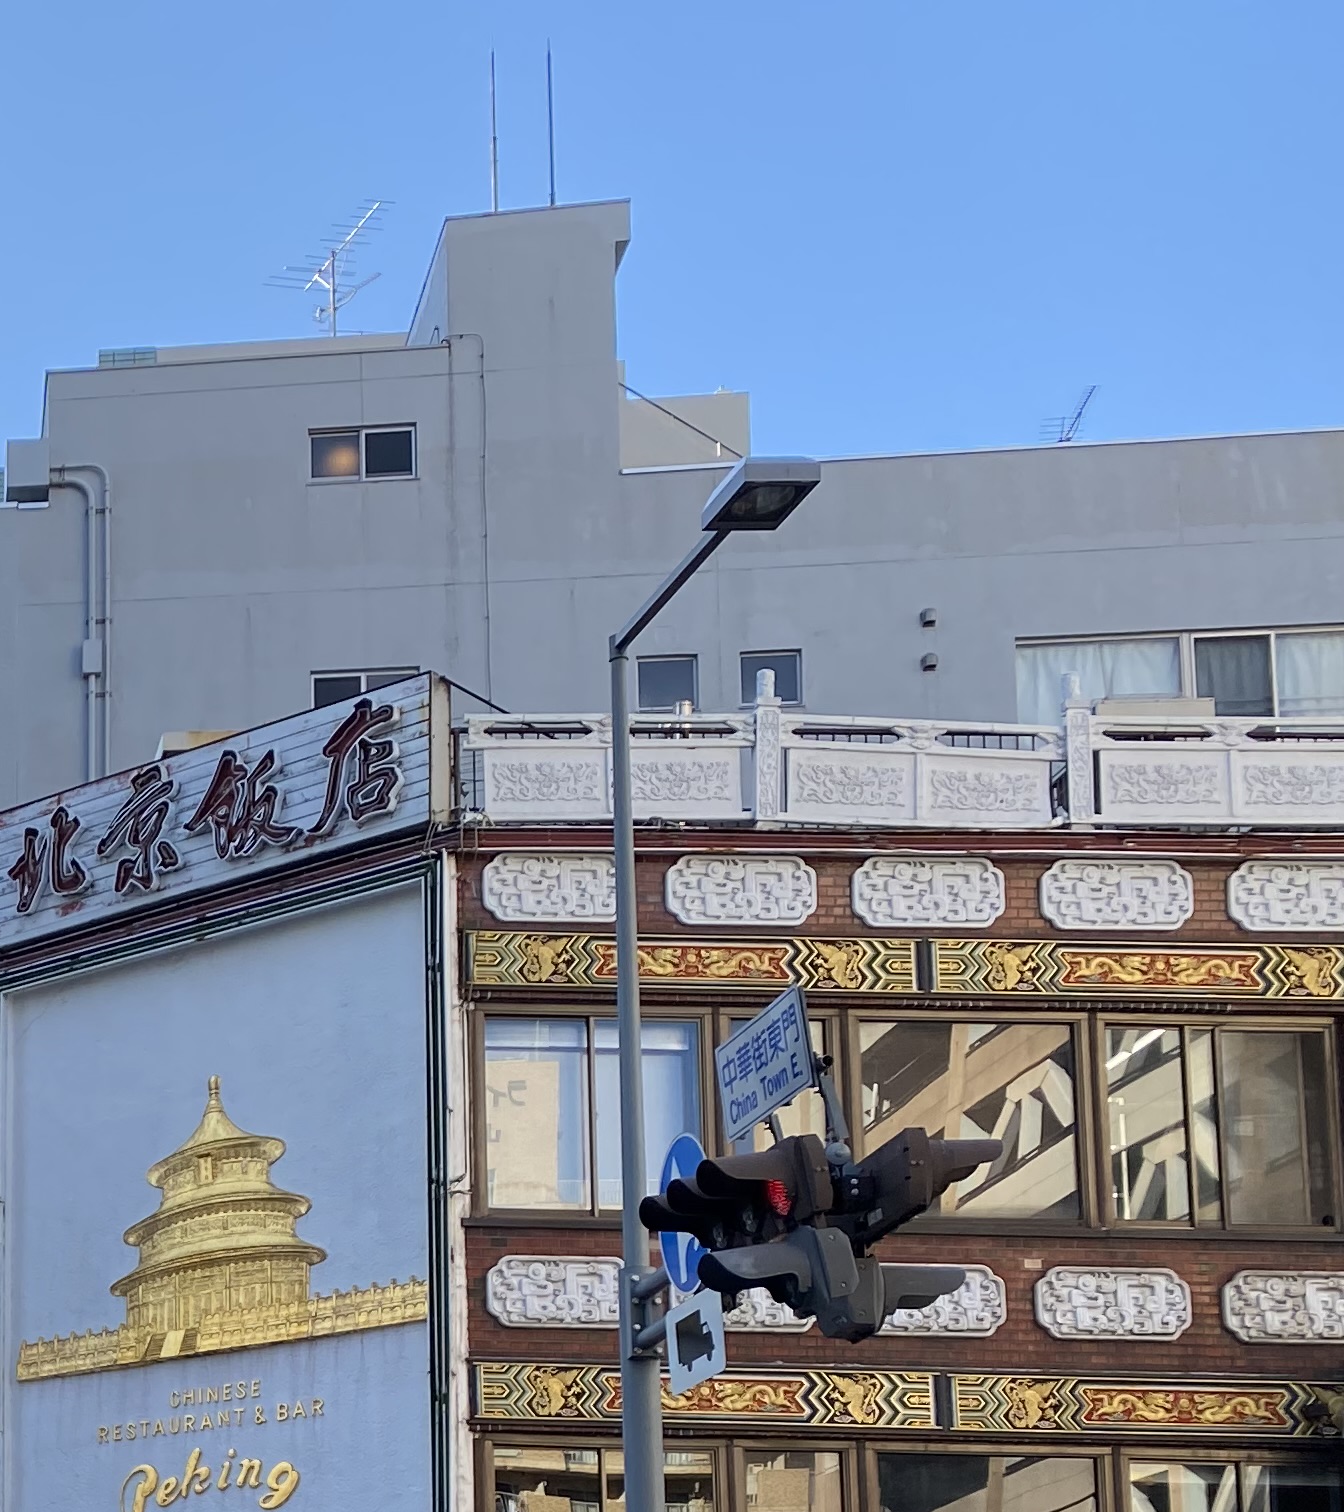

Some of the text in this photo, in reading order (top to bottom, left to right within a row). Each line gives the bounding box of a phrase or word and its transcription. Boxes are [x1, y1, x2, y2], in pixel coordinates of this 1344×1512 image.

[8, 697, 406, 915] 北京飯店
[721, 1003, 800, 1095] 中華街東門
[729, 1052, 804, 1125] China Town E.
[96, 1398, 325, 1445] RESTAURANT & BAR
[169, 1379, 262, 1409] CHINESE
